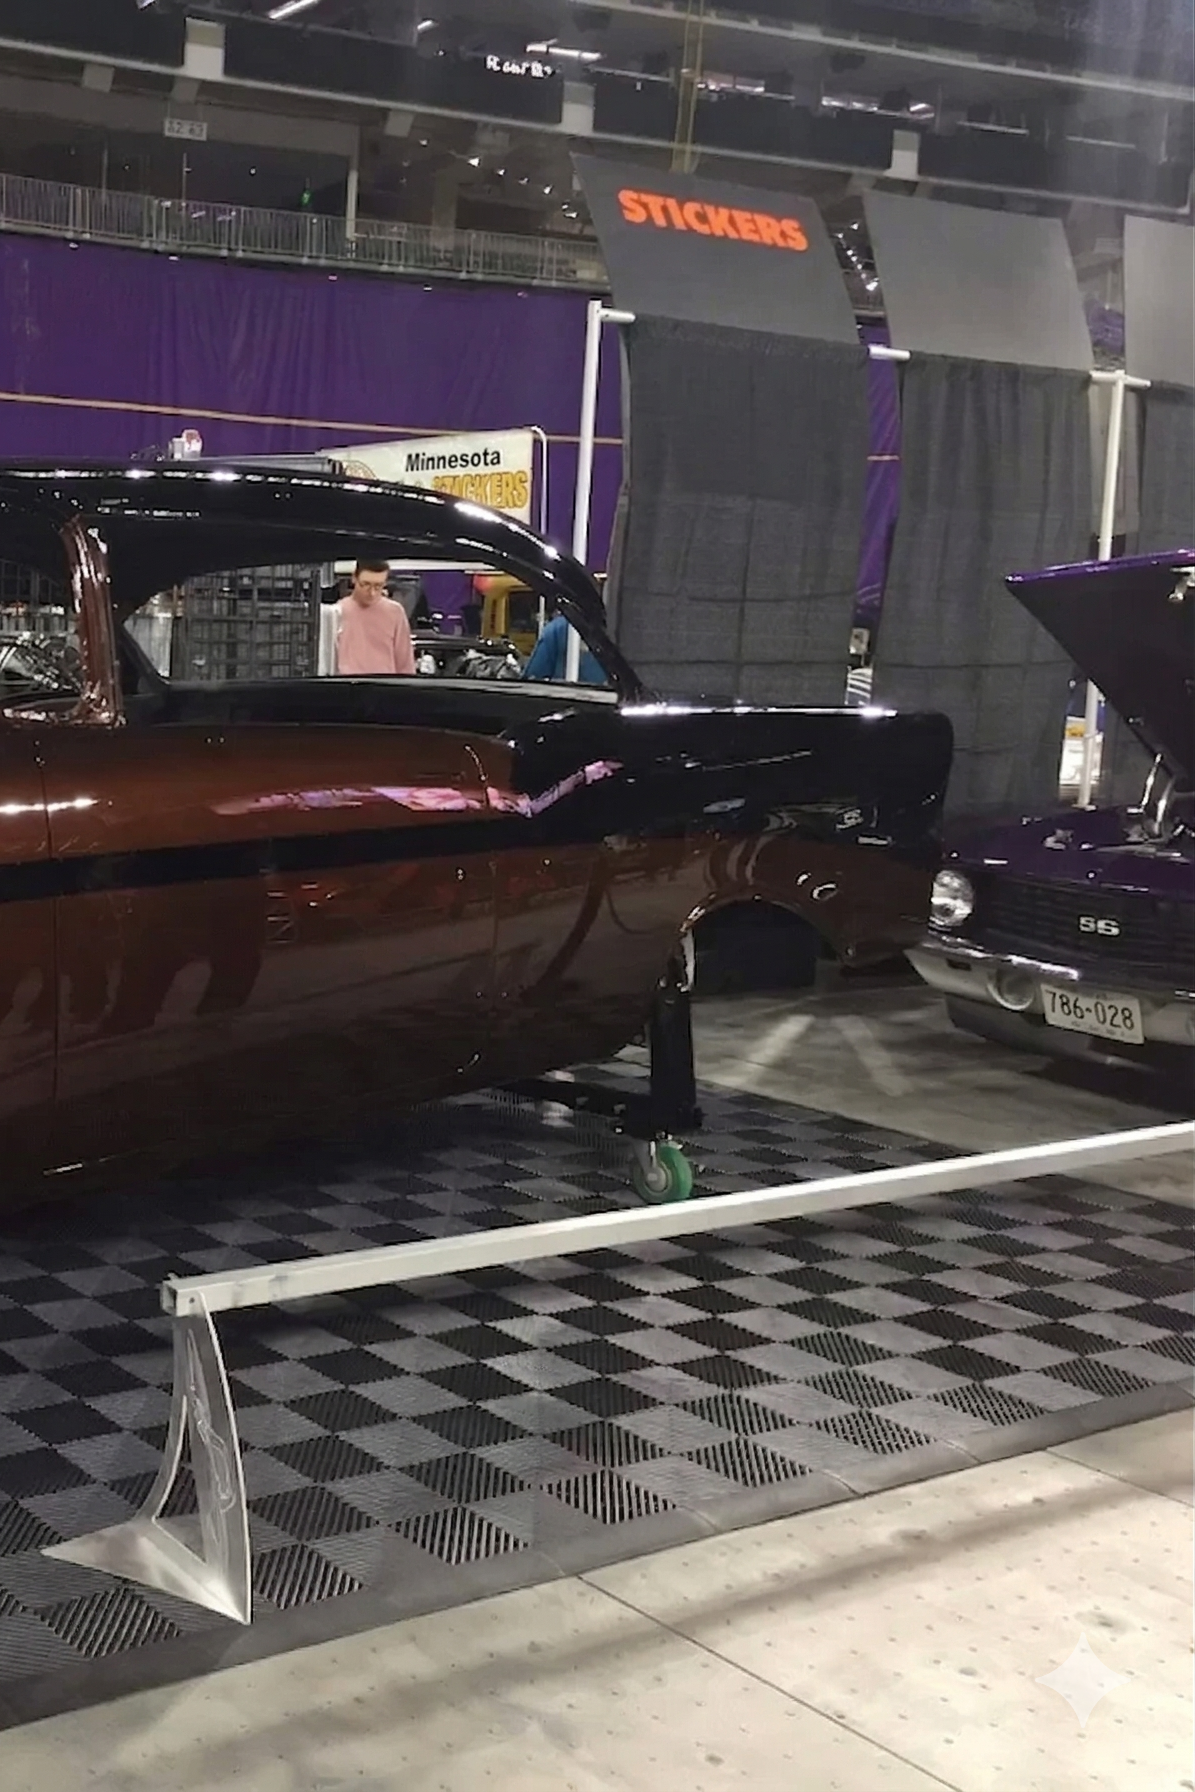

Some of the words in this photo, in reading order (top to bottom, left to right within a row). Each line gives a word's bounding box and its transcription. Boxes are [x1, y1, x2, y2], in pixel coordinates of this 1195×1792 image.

[618, 189, 808, 251] STICKERS
[405, 448, 501, 472] Minnesota
[1045, 989, 1134, 1031] 786-028
